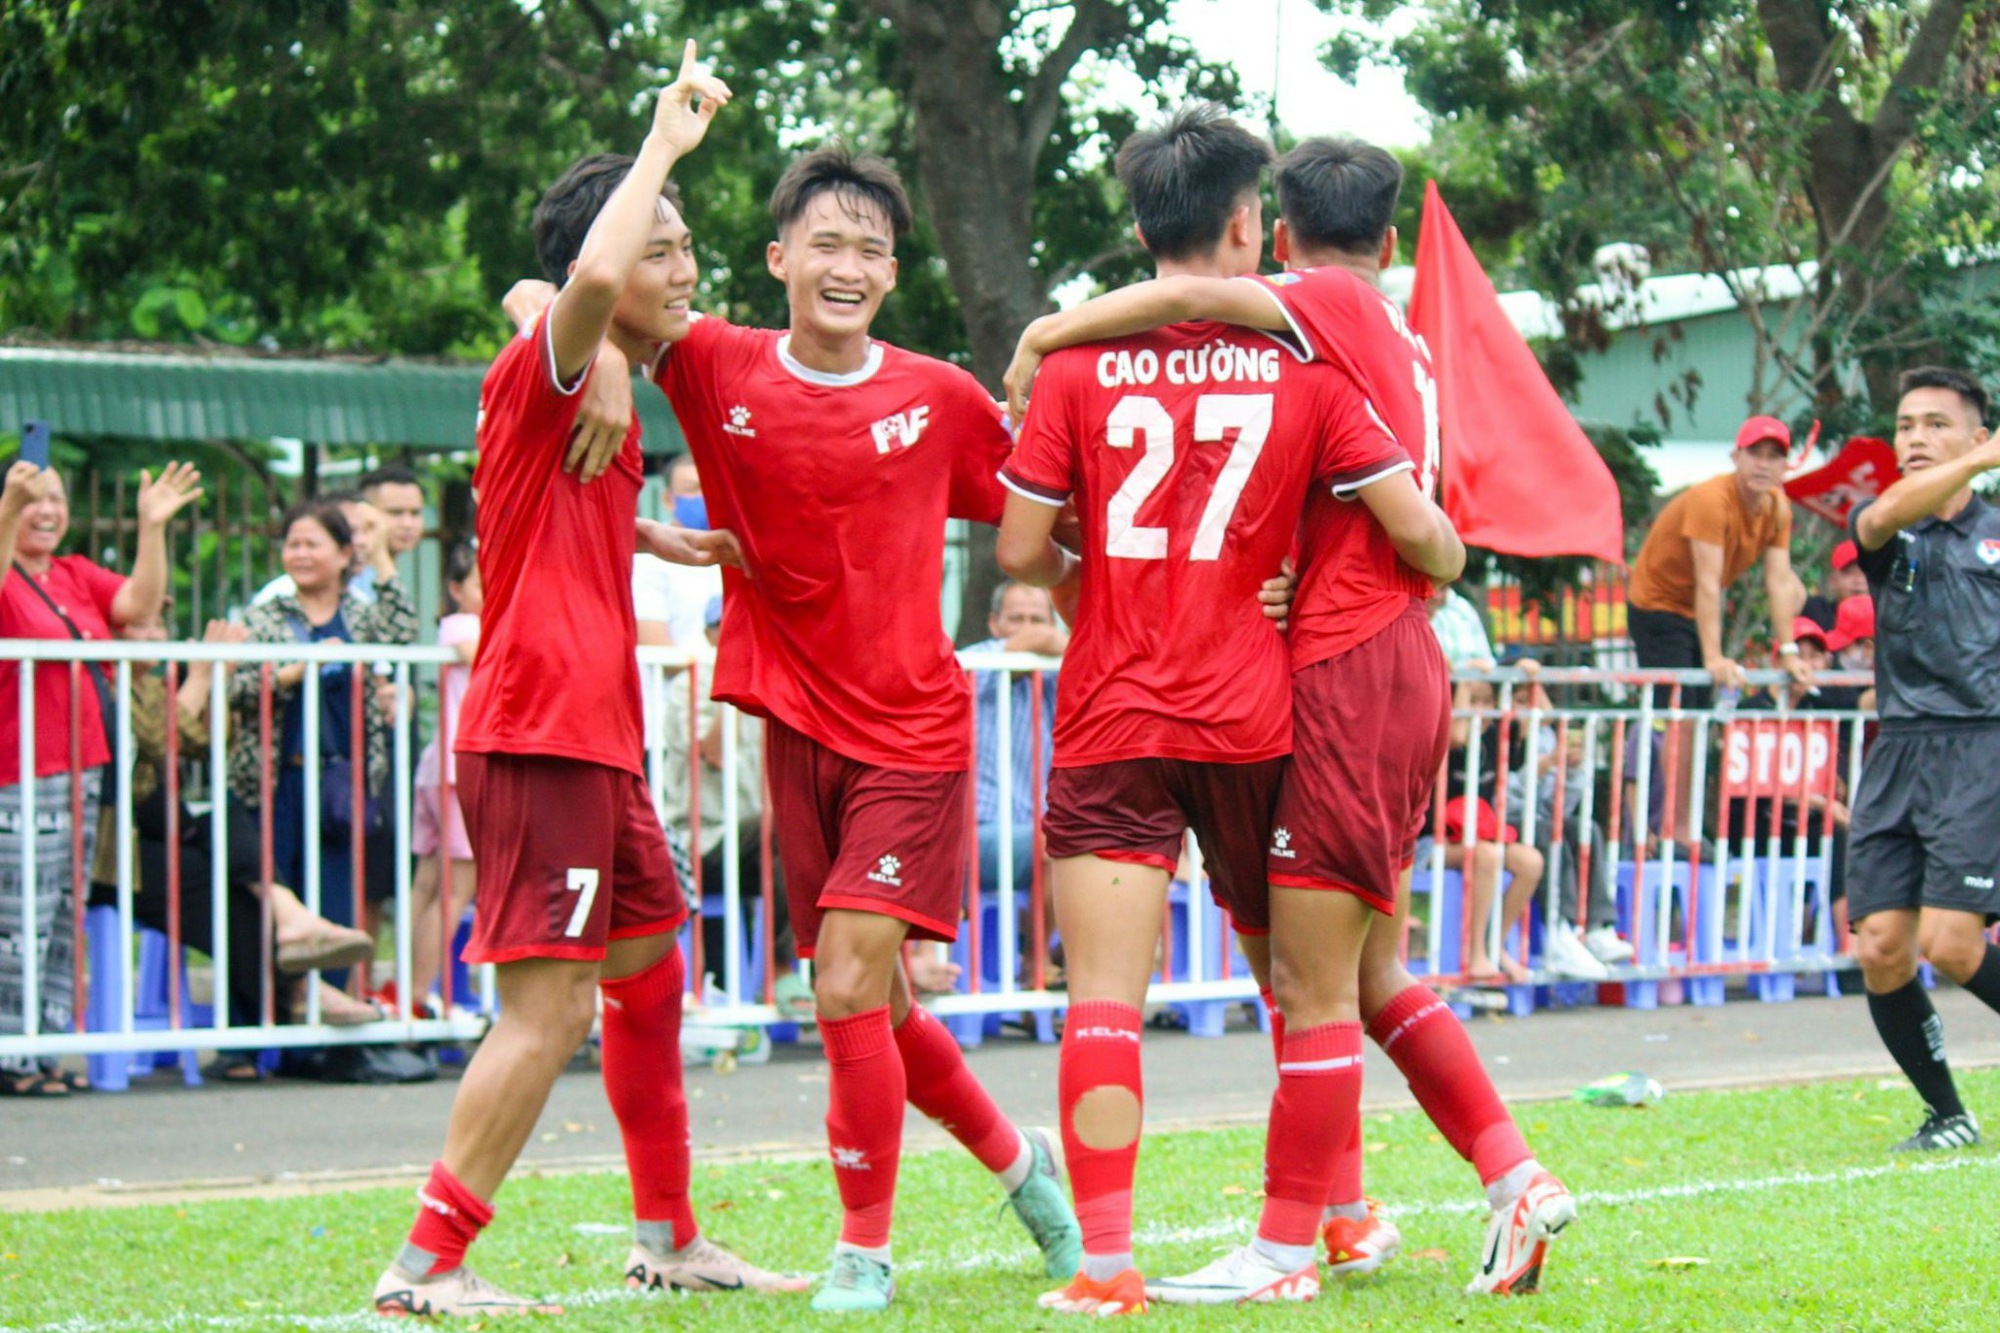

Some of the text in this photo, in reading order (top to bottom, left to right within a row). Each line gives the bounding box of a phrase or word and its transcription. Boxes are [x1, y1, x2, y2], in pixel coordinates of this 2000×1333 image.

[1097, 338, 1280, 388] CAO CƯỜNG
[1105, 393, 1274, 561] 27
[1726, 730, 1828, 786] STOP
[564, 867, 600, 938] 7
[1076, 1025, 1140, 1043] KELME
